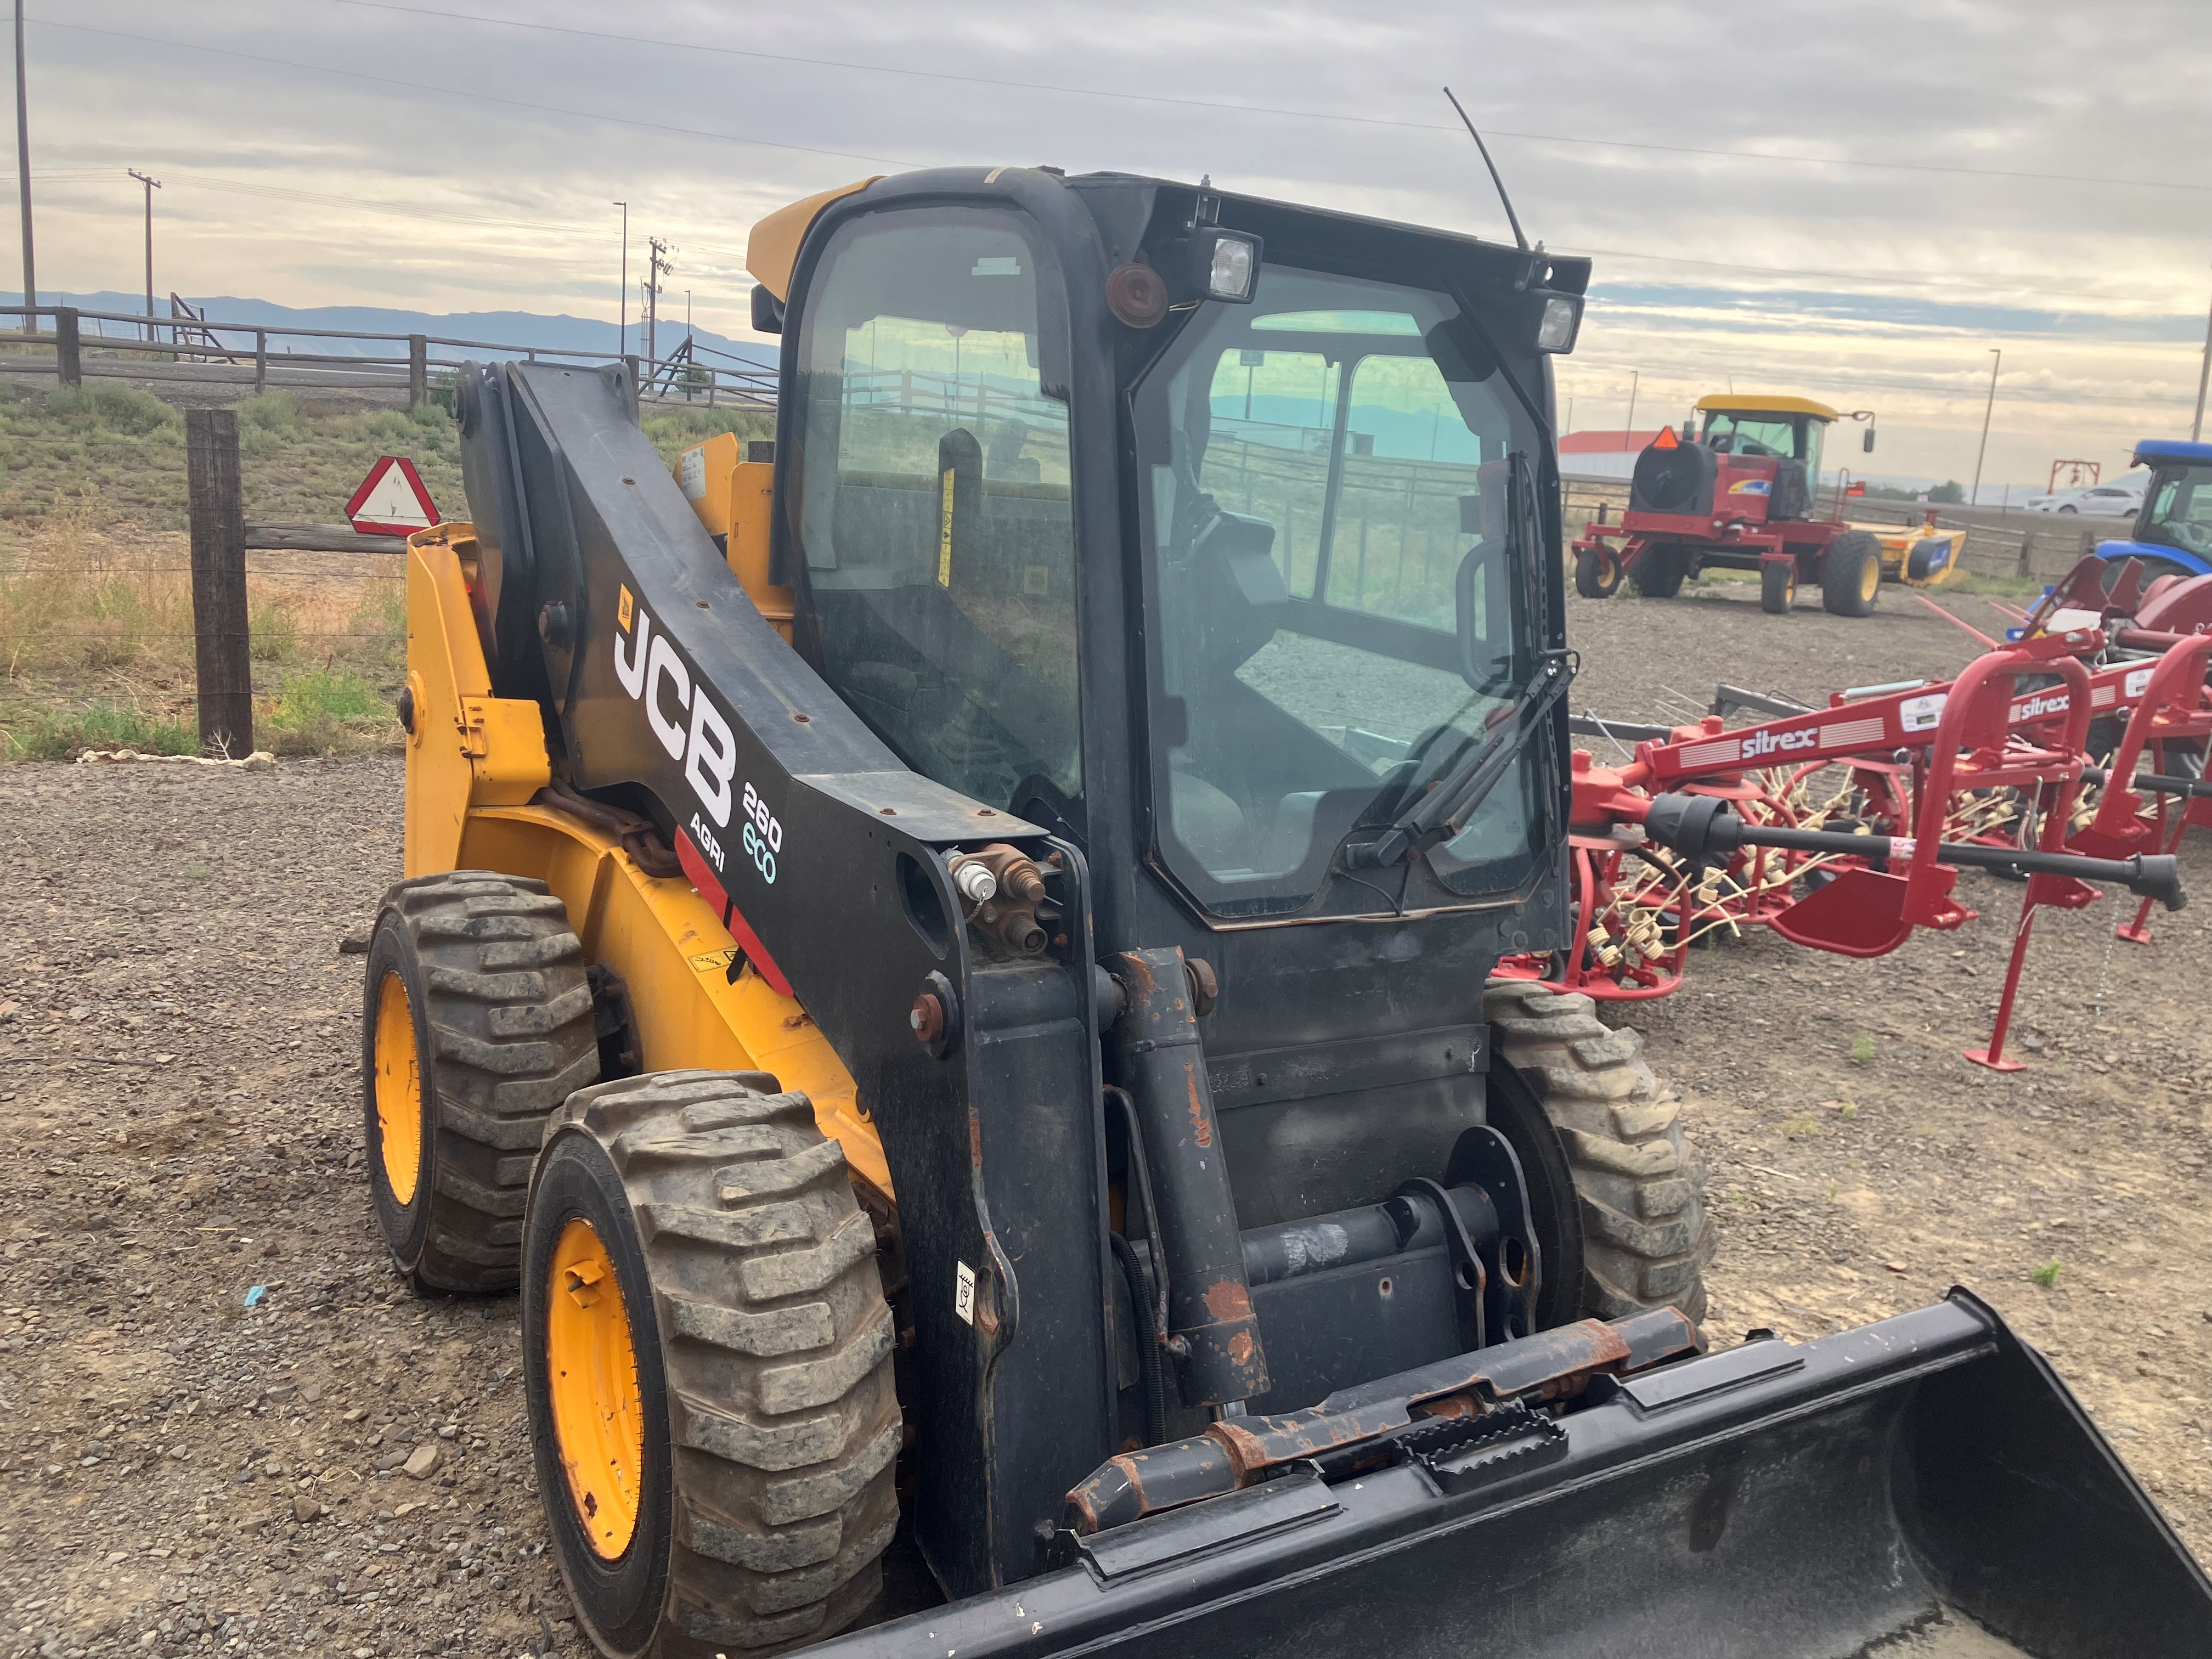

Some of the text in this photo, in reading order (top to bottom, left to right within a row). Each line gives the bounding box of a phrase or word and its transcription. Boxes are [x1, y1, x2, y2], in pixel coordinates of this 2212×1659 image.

[614, 608, 736, 828] JCB
[2021, 695, 2070, 720] sitrex
[1742, 727, 1818, 759] sitrex
[690, 812, 725, 873] AGRI
[742, 781, 782, 853] 260
[743, 822, 776, 884] eco
